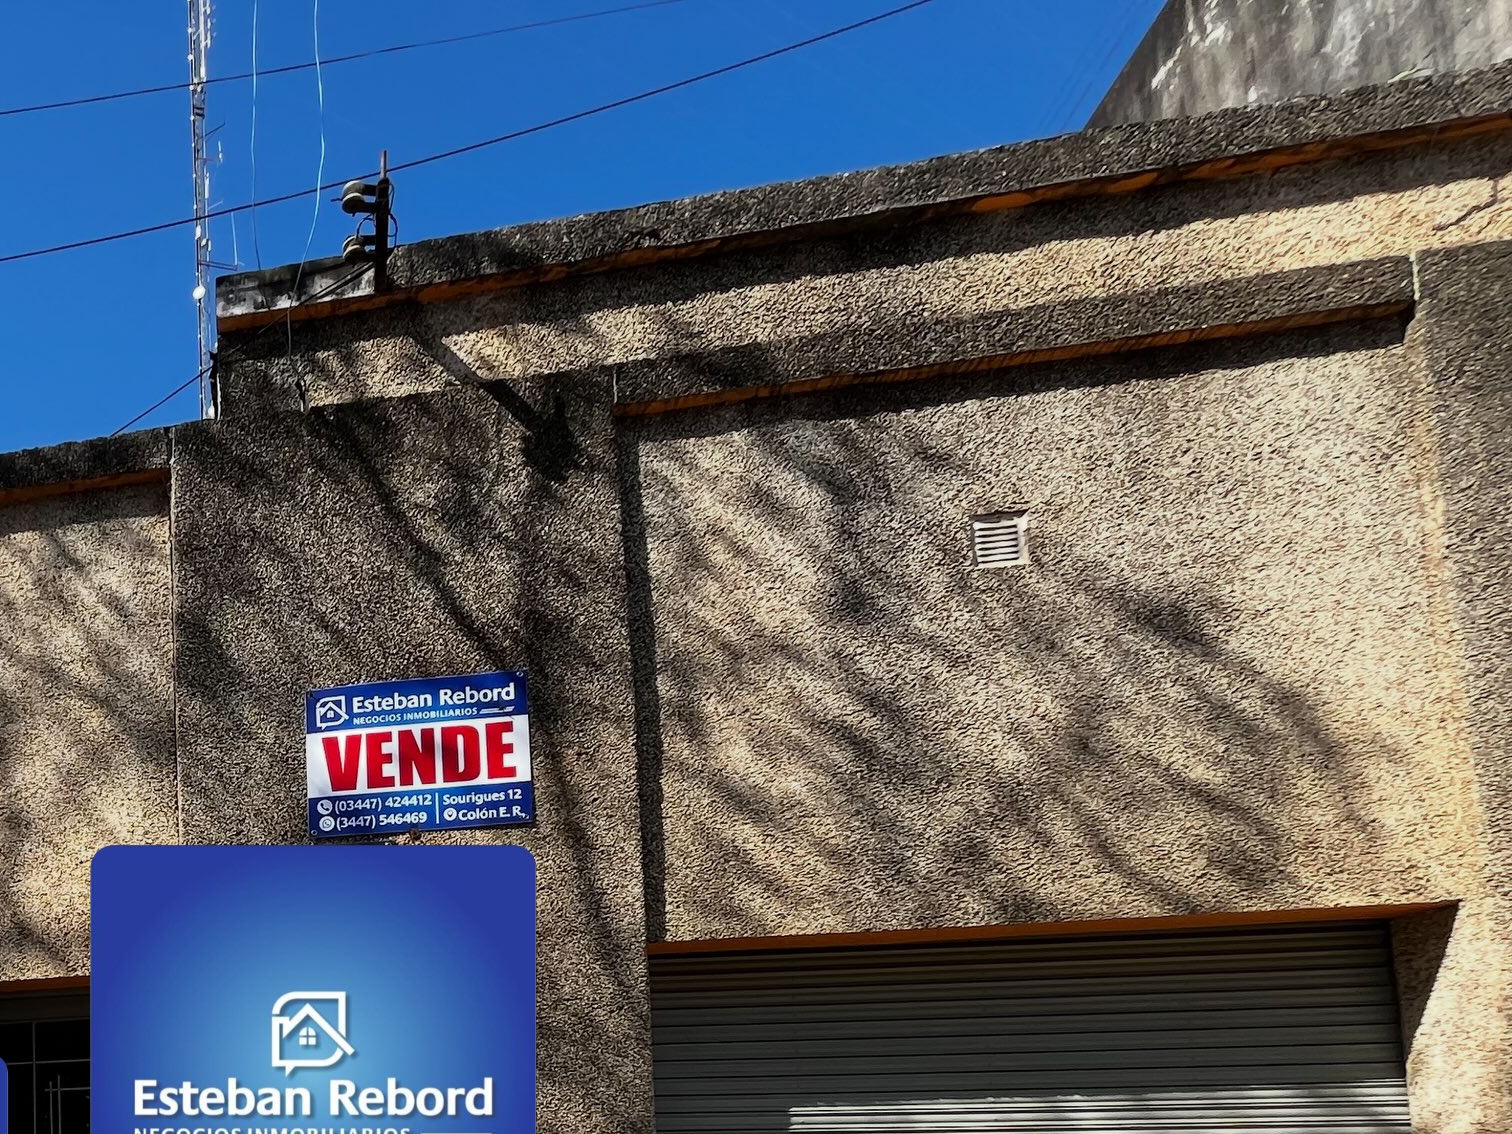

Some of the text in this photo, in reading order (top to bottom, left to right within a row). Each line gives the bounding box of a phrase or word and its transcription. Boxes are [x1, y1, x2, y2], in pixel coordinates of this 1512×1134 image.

[352, 682, 515, 713] Esteban Rebord
[353, 707, 478, 726] NEGOCIOS INMOBILIARIOS
[322, 721, 518, 792] VENDE
[334, 794, 433, 815] (03447) 424412
[442, 788, 522, 806] Sourigues 12
[336, 811, 428, 831] (3447) 546469
[458, 807, 497, 821] Colón
